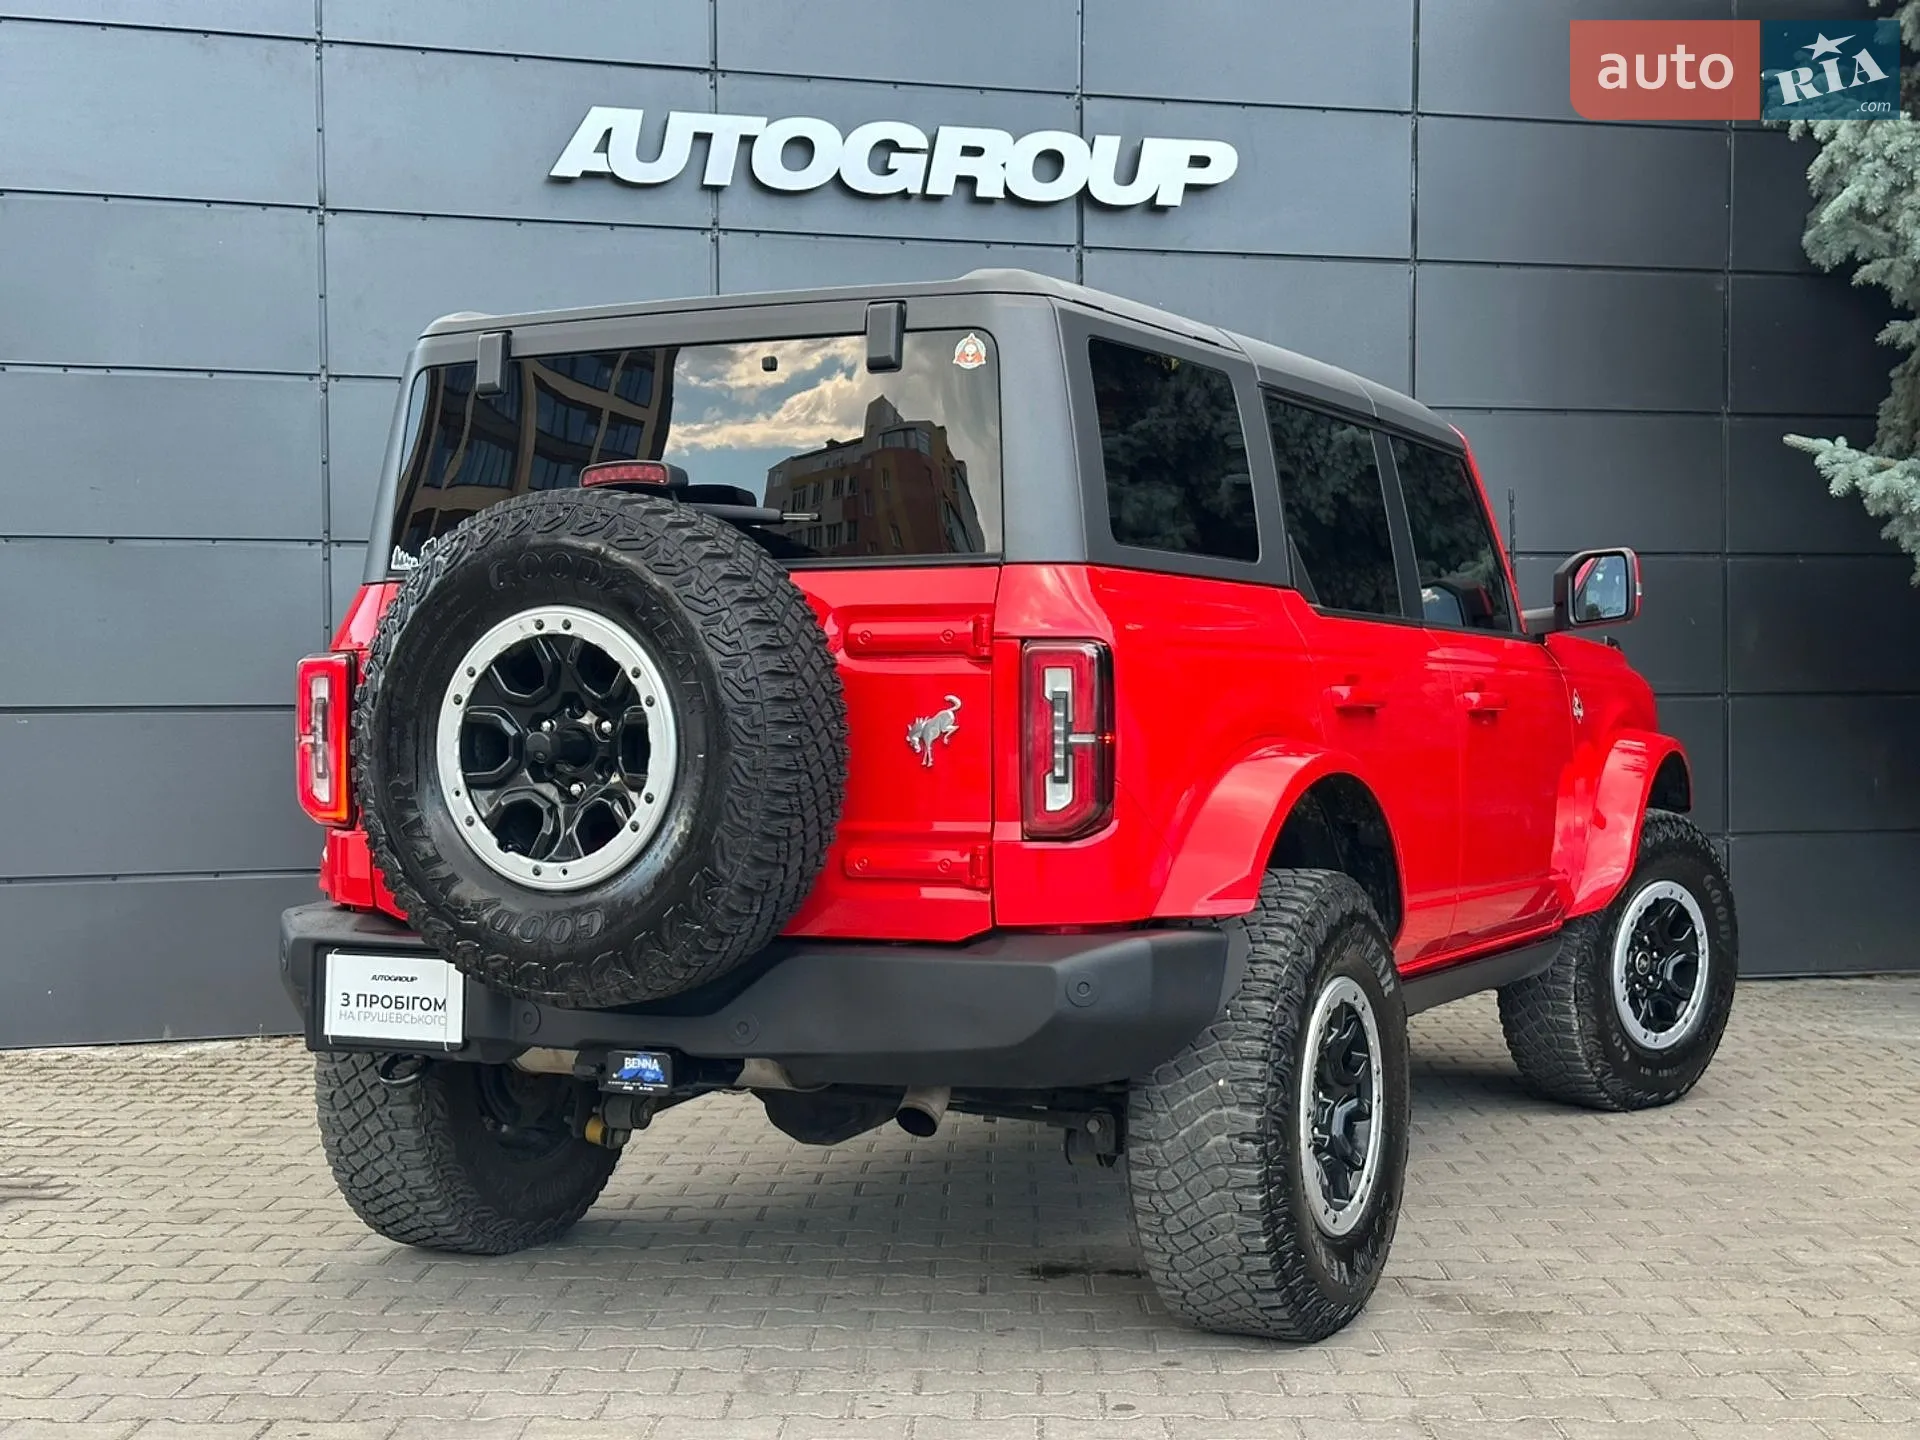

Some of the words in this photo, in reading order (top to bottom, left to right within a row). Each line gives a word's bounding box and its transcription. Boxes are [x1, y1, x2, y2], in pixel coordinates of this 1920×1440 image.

[549, 106, 1239, 207] AUTOGROUP
[340, 992, 351, 1007] З
[356, 992, 447, 1012] ПРОБІГОМ
[339, 1010, 355, 1021] НА
[357, 1010, 447, 1027] ГРУШЕВСЬКОГО
